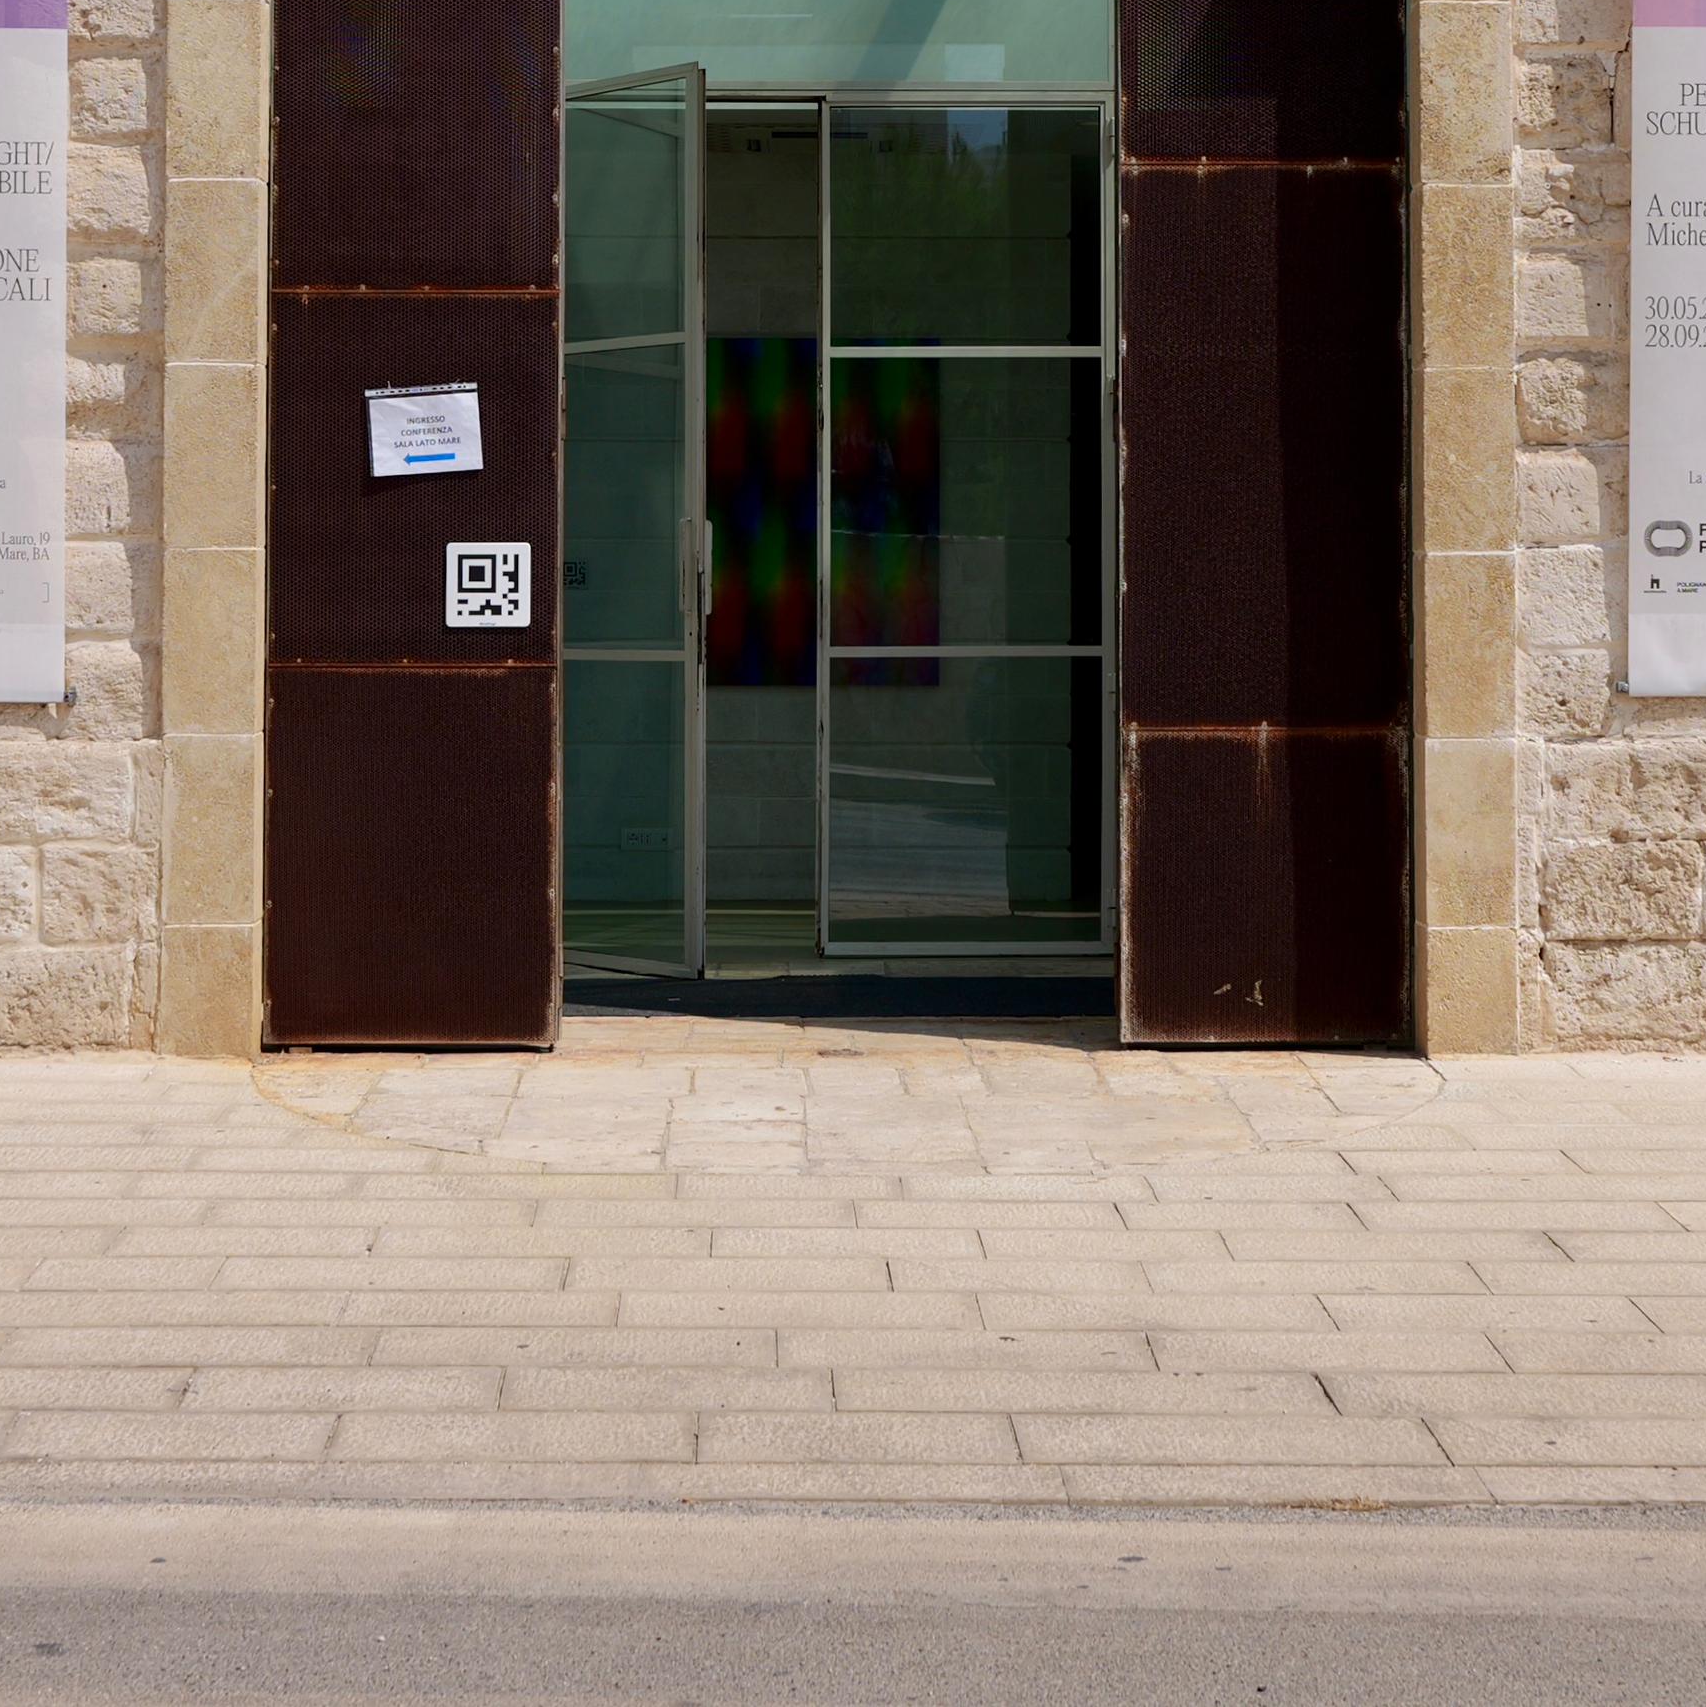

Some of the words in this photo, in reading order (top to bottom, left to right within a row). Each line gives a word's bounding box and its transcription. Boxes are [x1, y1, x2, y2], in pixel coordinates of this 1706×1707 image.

[1647, 194, 1664, 217] A
[406, 415, 446, 425] INGRESSO
[400, 426, 453, 437] CONFERENZA
[394, 439, 414, 449] SALA
[415, 439, 436, 447] LATO
[438, 437, 462, 445] MARE
[1689, 470, 1703, 484] La
[39, 532, 51, 545] 19
[32, 547, 50, 560] BA
